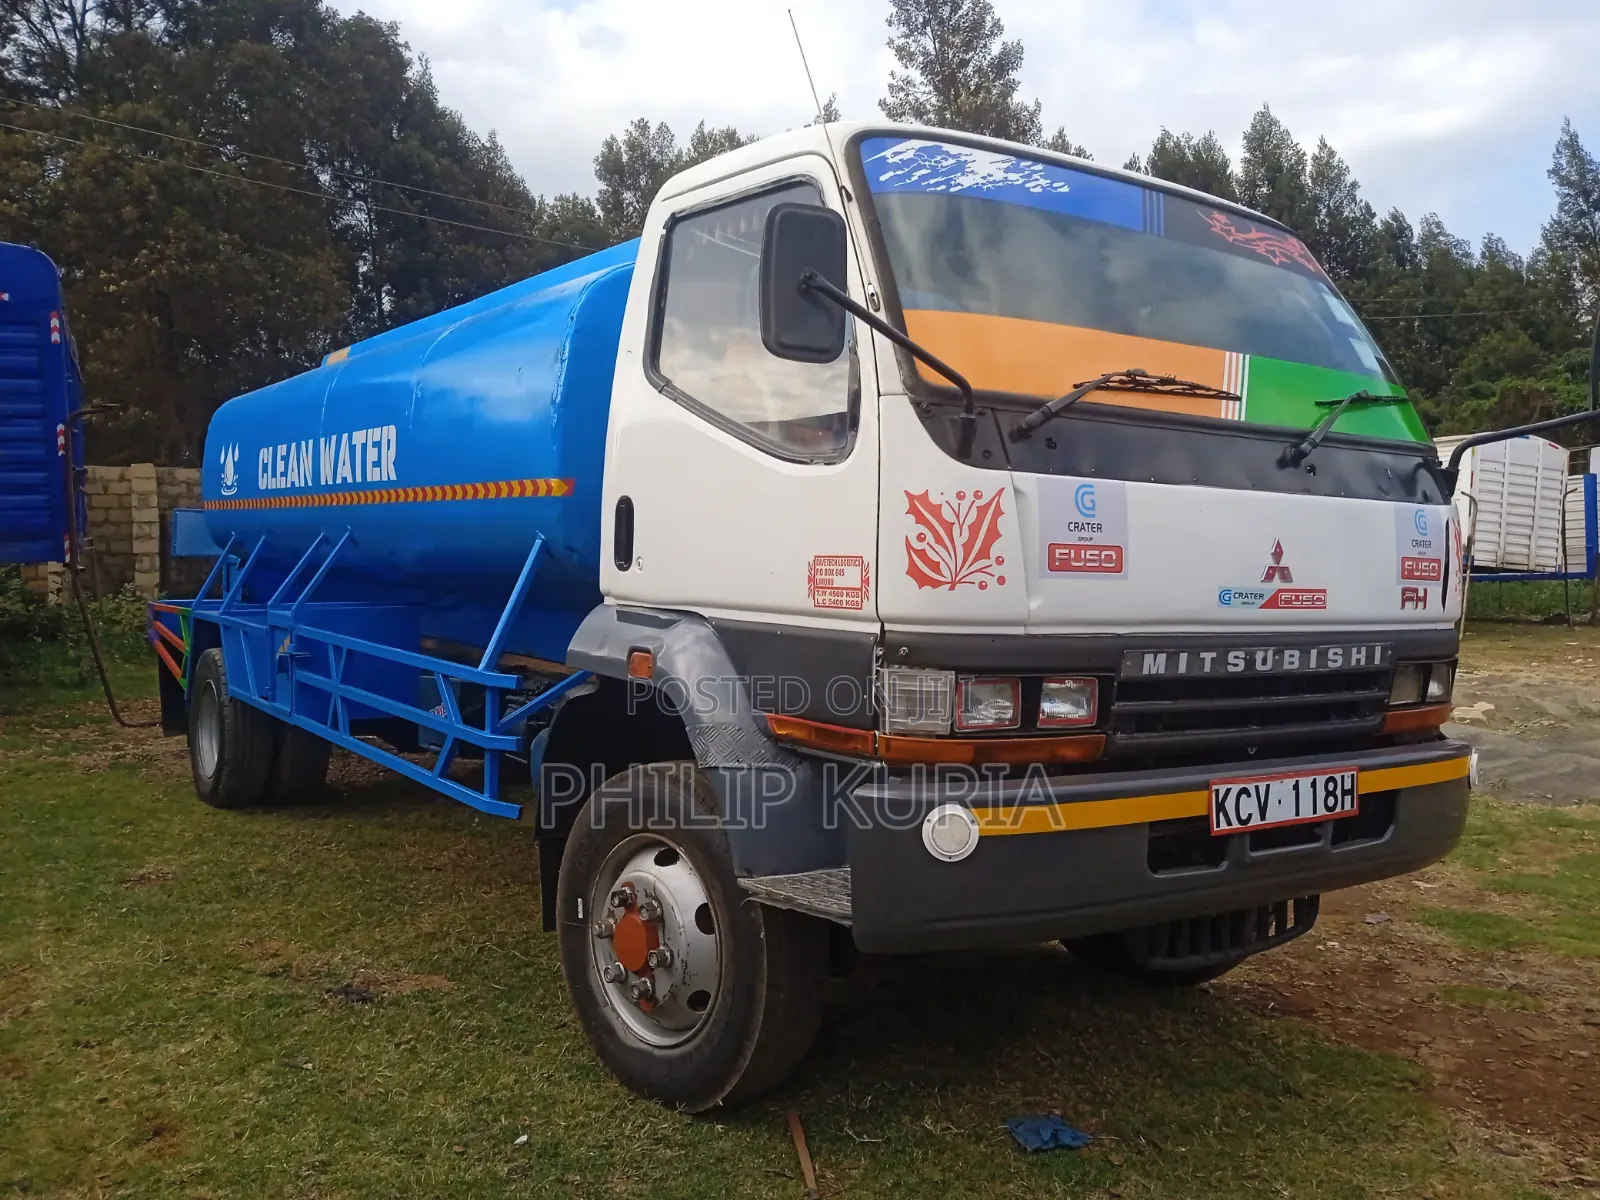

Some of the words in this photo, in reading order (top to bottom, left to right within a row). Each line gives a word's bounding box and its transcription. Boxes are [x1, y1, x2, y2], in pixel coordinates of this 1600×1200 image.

[258, 439, 313, 490] CLEAN
[320, 425, 398, 485] WATER
[1067, 521, 1103, 533] CRATER
[1411, 539, 1432, 549] CRATER
[1055, 548, 1117, 568] FUSO
[824, 569, 835, 577] BOX
[1404, 561, 1438, 576] FUSO
[1233, 592, 1265, 600] CRATER
[1281, 594, 1325, 605] FUSO
[1142, 645, 1382, 675] MITSUBISHI
